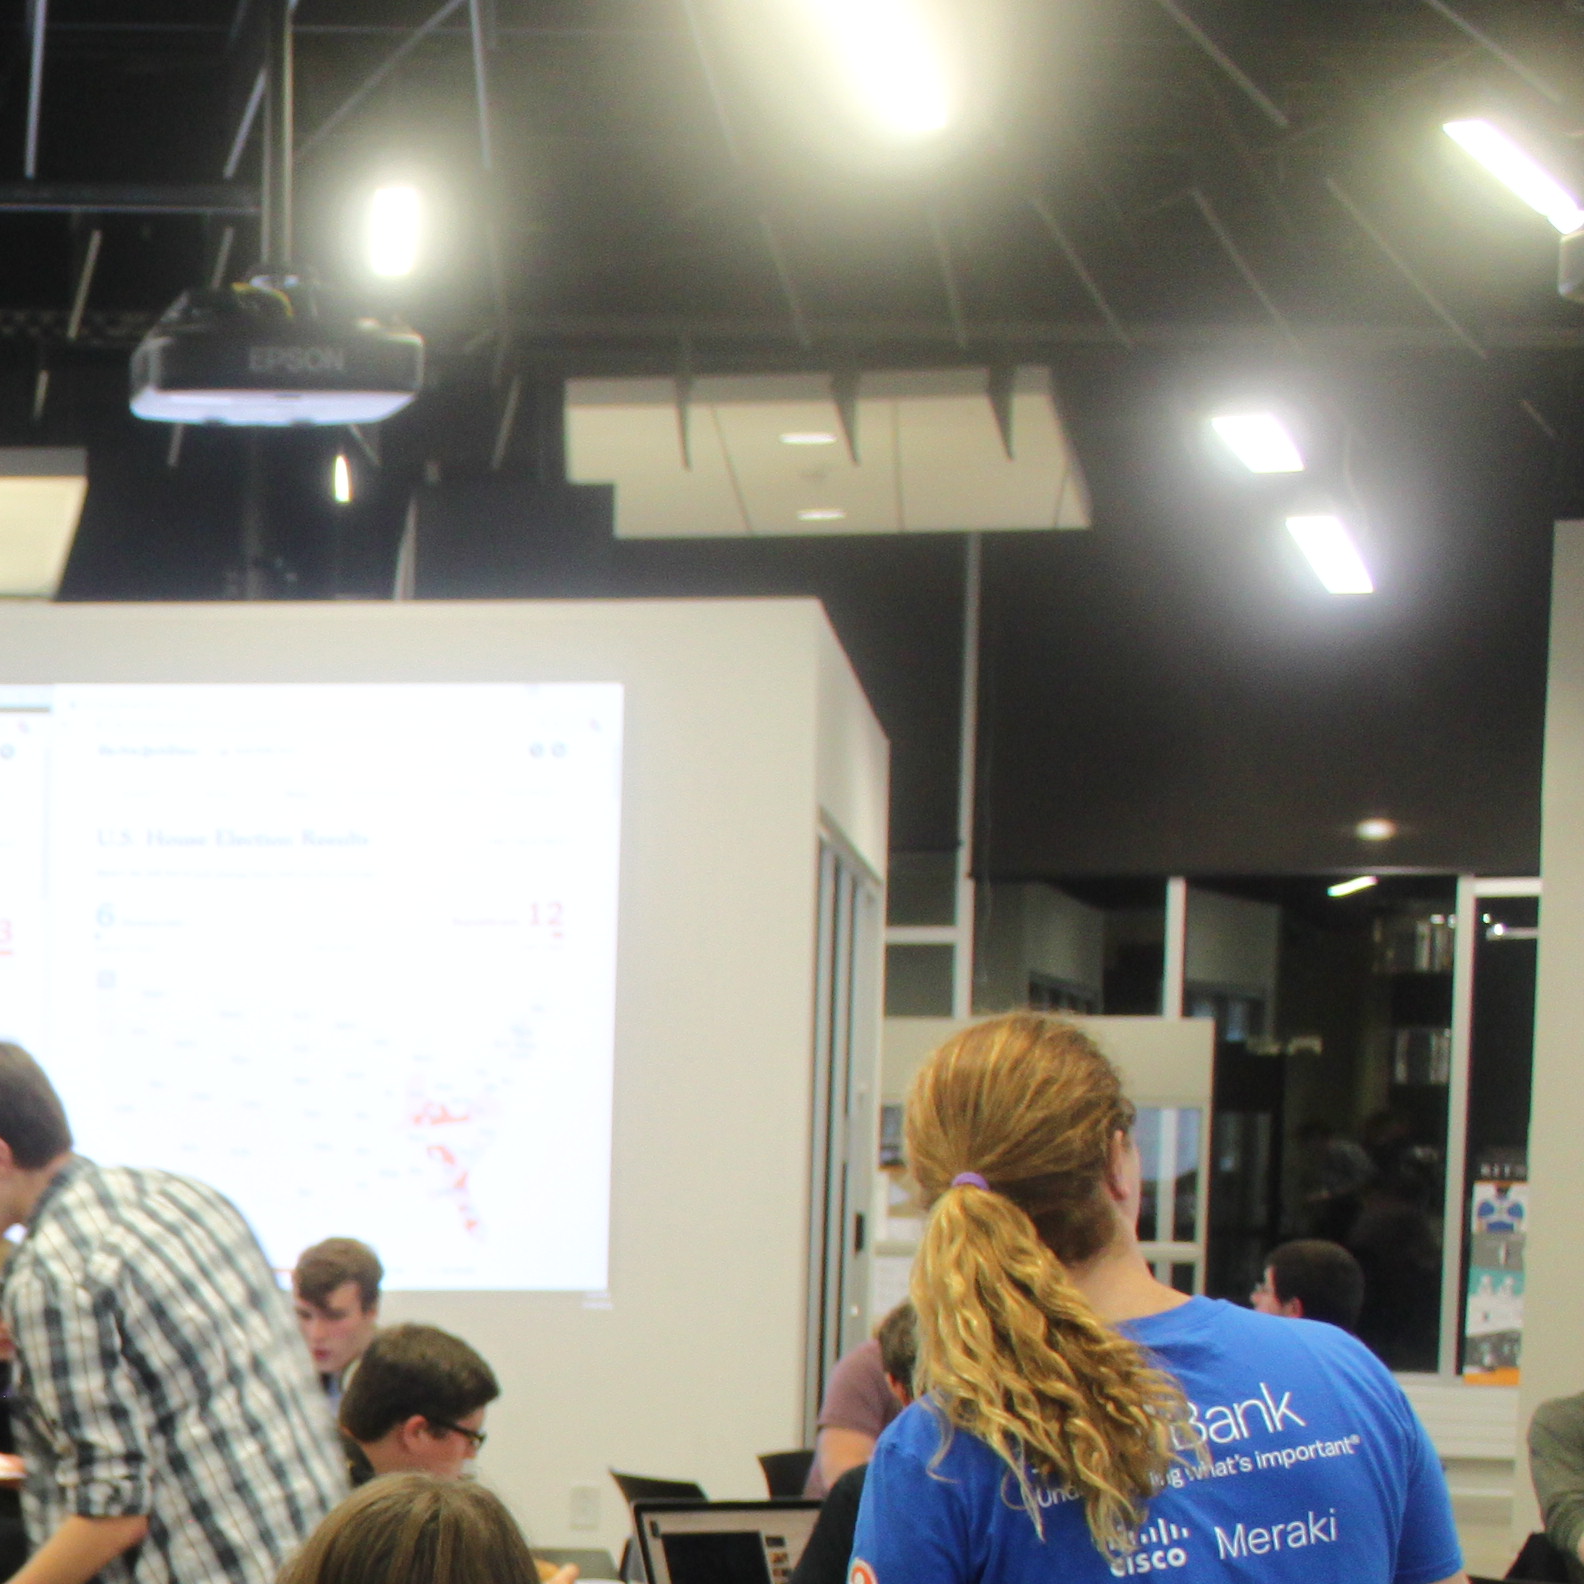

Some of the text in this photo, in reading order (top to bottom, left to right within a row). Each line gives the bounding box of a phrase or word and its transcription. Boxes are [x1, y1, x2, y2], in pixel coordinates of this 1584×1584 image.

[249, 348, 344, 372] EPSON
[528, 901, 564, 928] 12
[1170, 1382, 1306, 1451] Bank
[1214, 1508, 1338, 1560] Meraki
